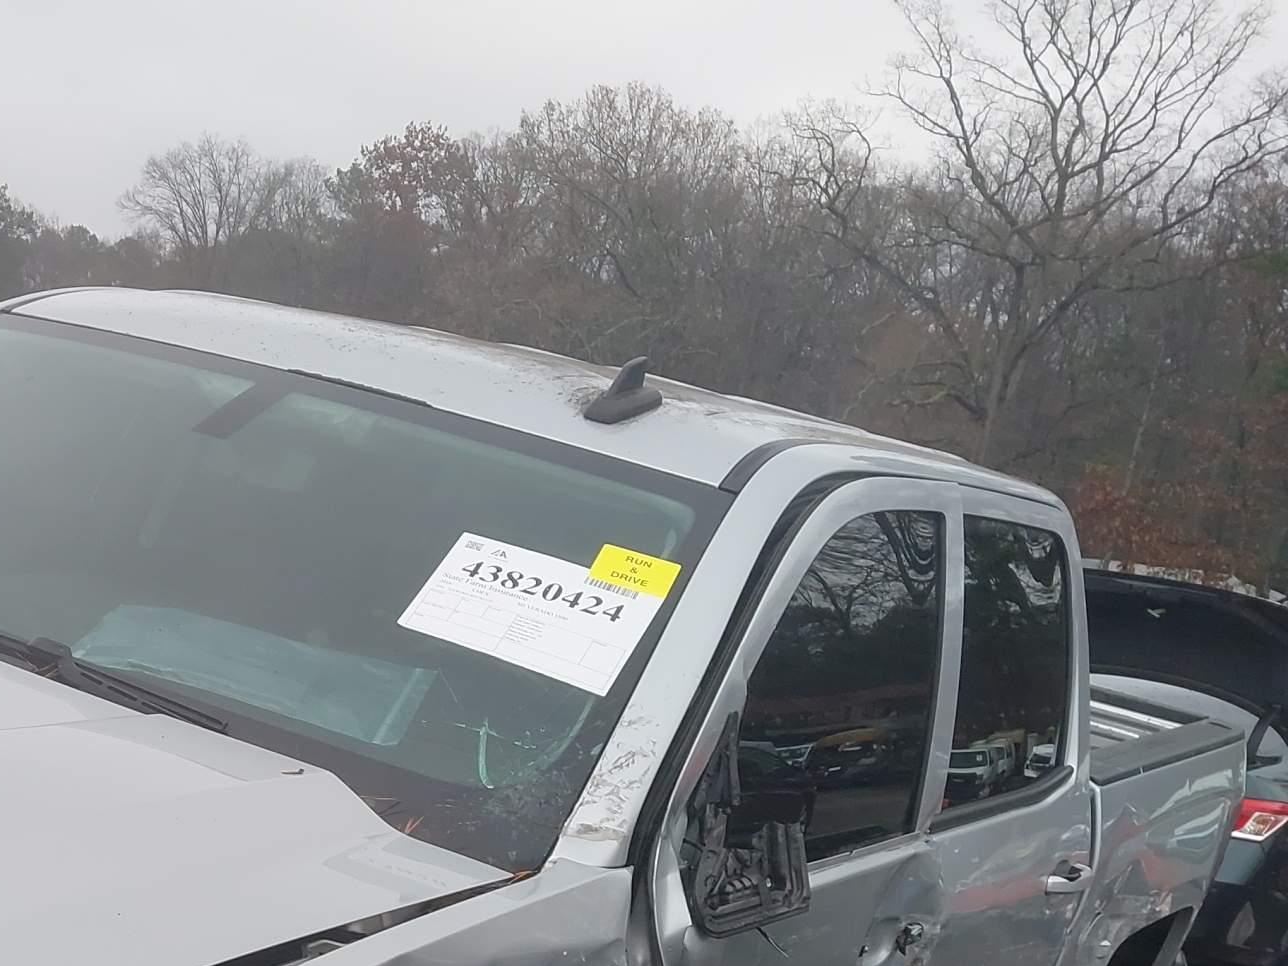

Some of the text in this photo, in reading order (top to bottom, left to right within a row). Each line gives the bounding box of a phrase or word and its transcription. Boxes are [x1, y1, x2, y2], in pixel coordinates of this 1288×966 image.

[625, 555, 653, 569] RUN
[610, 570, 649, 587] DRIVE
[629, 567, 640, 575] &
[461, 560, 625, 623] 43820424
